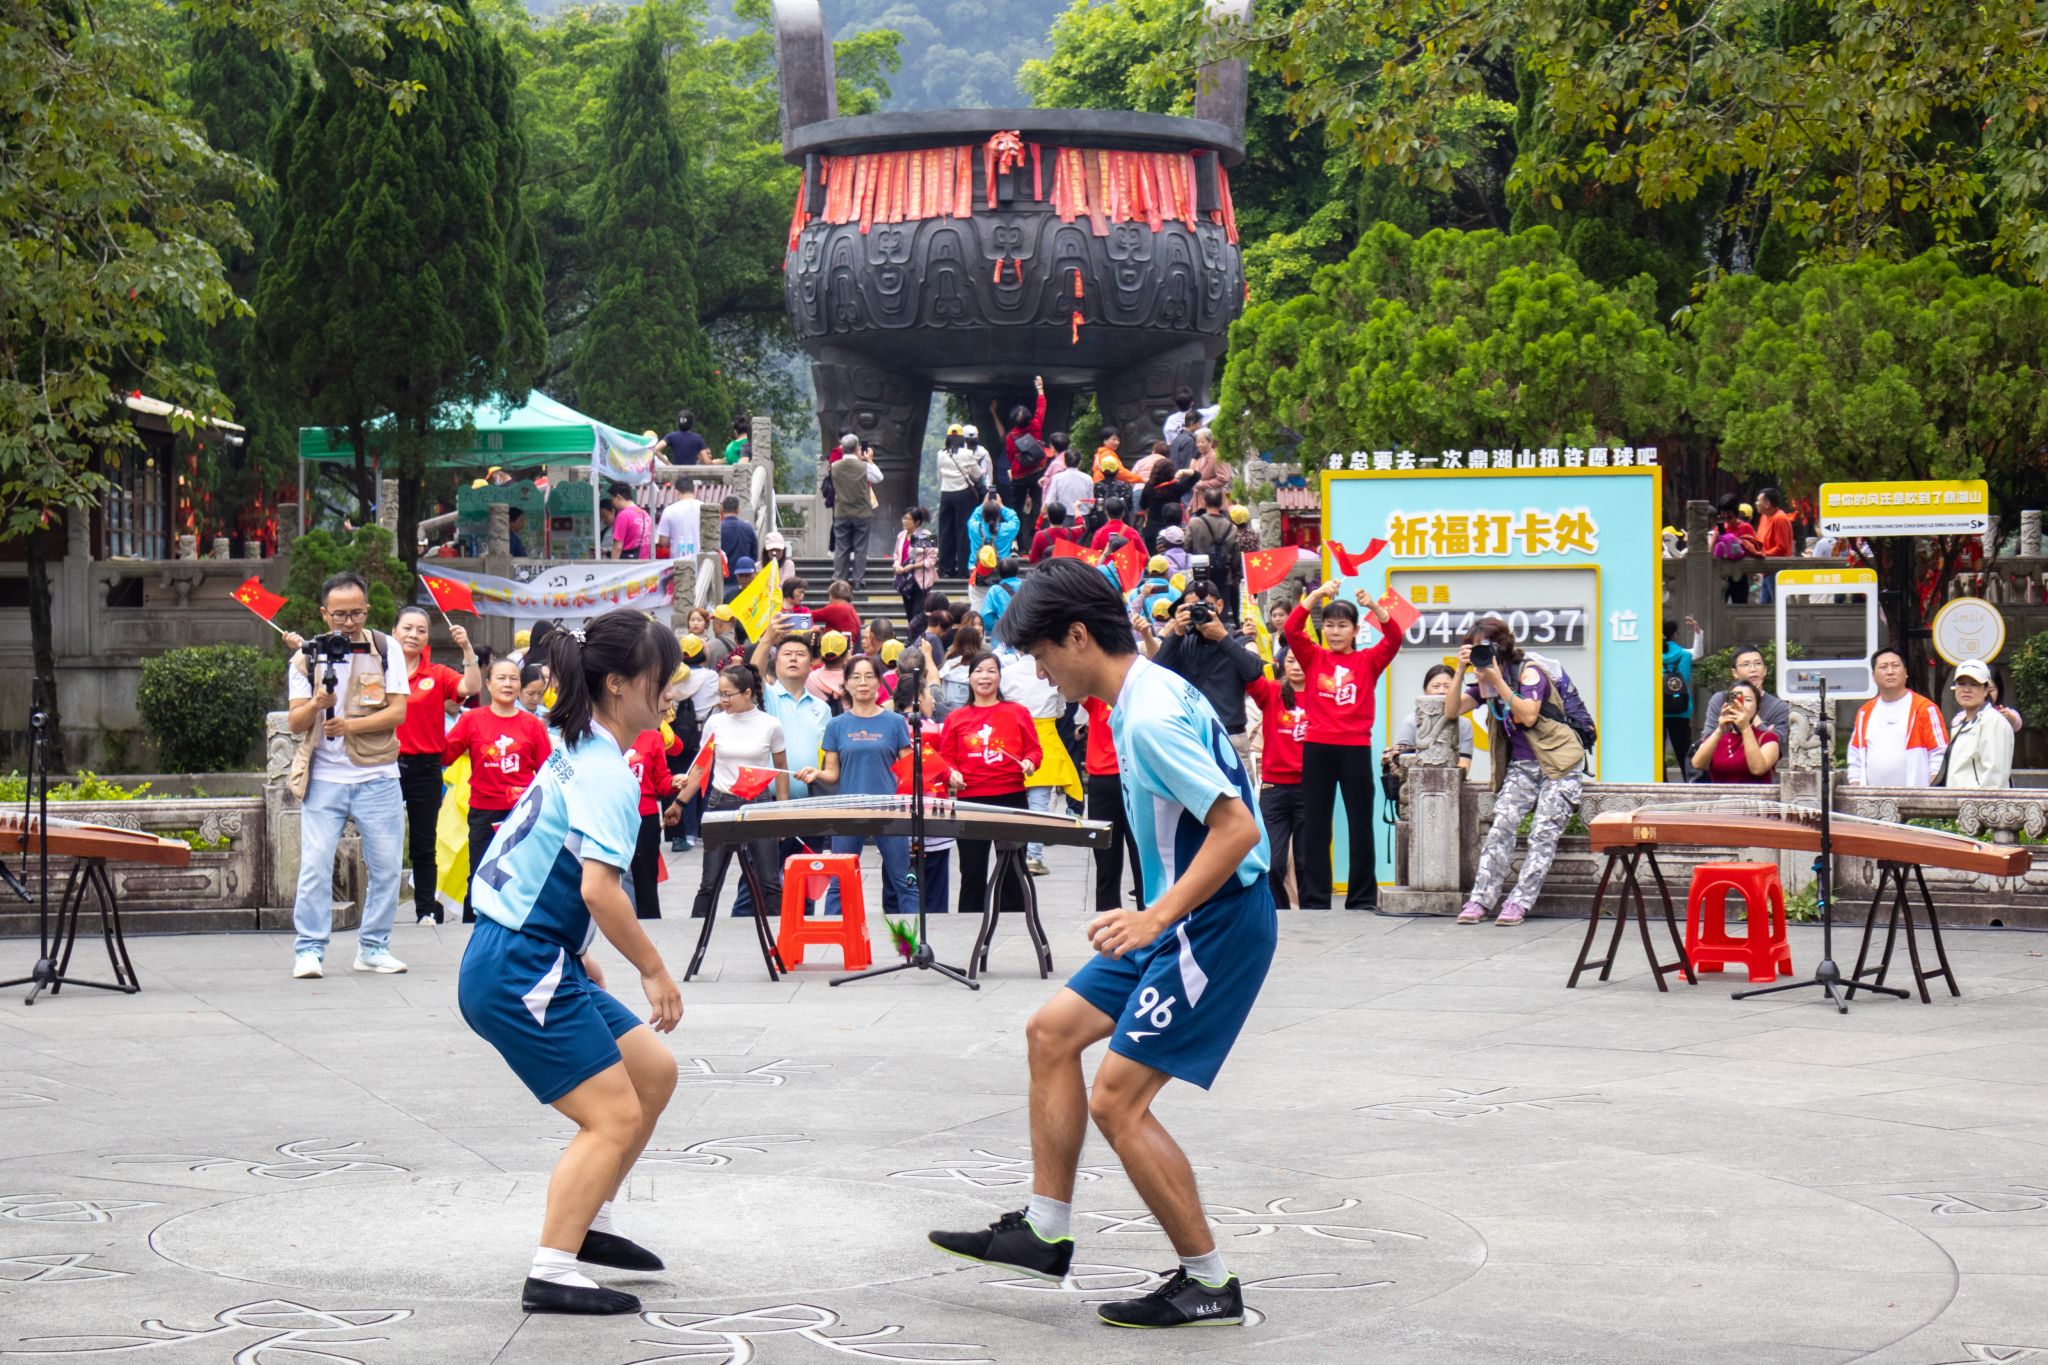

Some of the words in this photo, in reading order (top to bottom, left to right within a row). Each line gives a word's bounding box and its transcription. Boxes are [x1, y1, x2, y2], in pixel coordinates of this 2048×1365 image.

[1388, 509, 1599, 557] 祈福打卡处
[1832, 523, 1841, 532] N
[1970, 520, 1978, 529] S
[1410, 585, 1451, 604] 我是
[1403, 609, 1582, 645] 044037
[1609, 608, 1639, 642] 位
[1134, 985, 1177, 1029] 96
